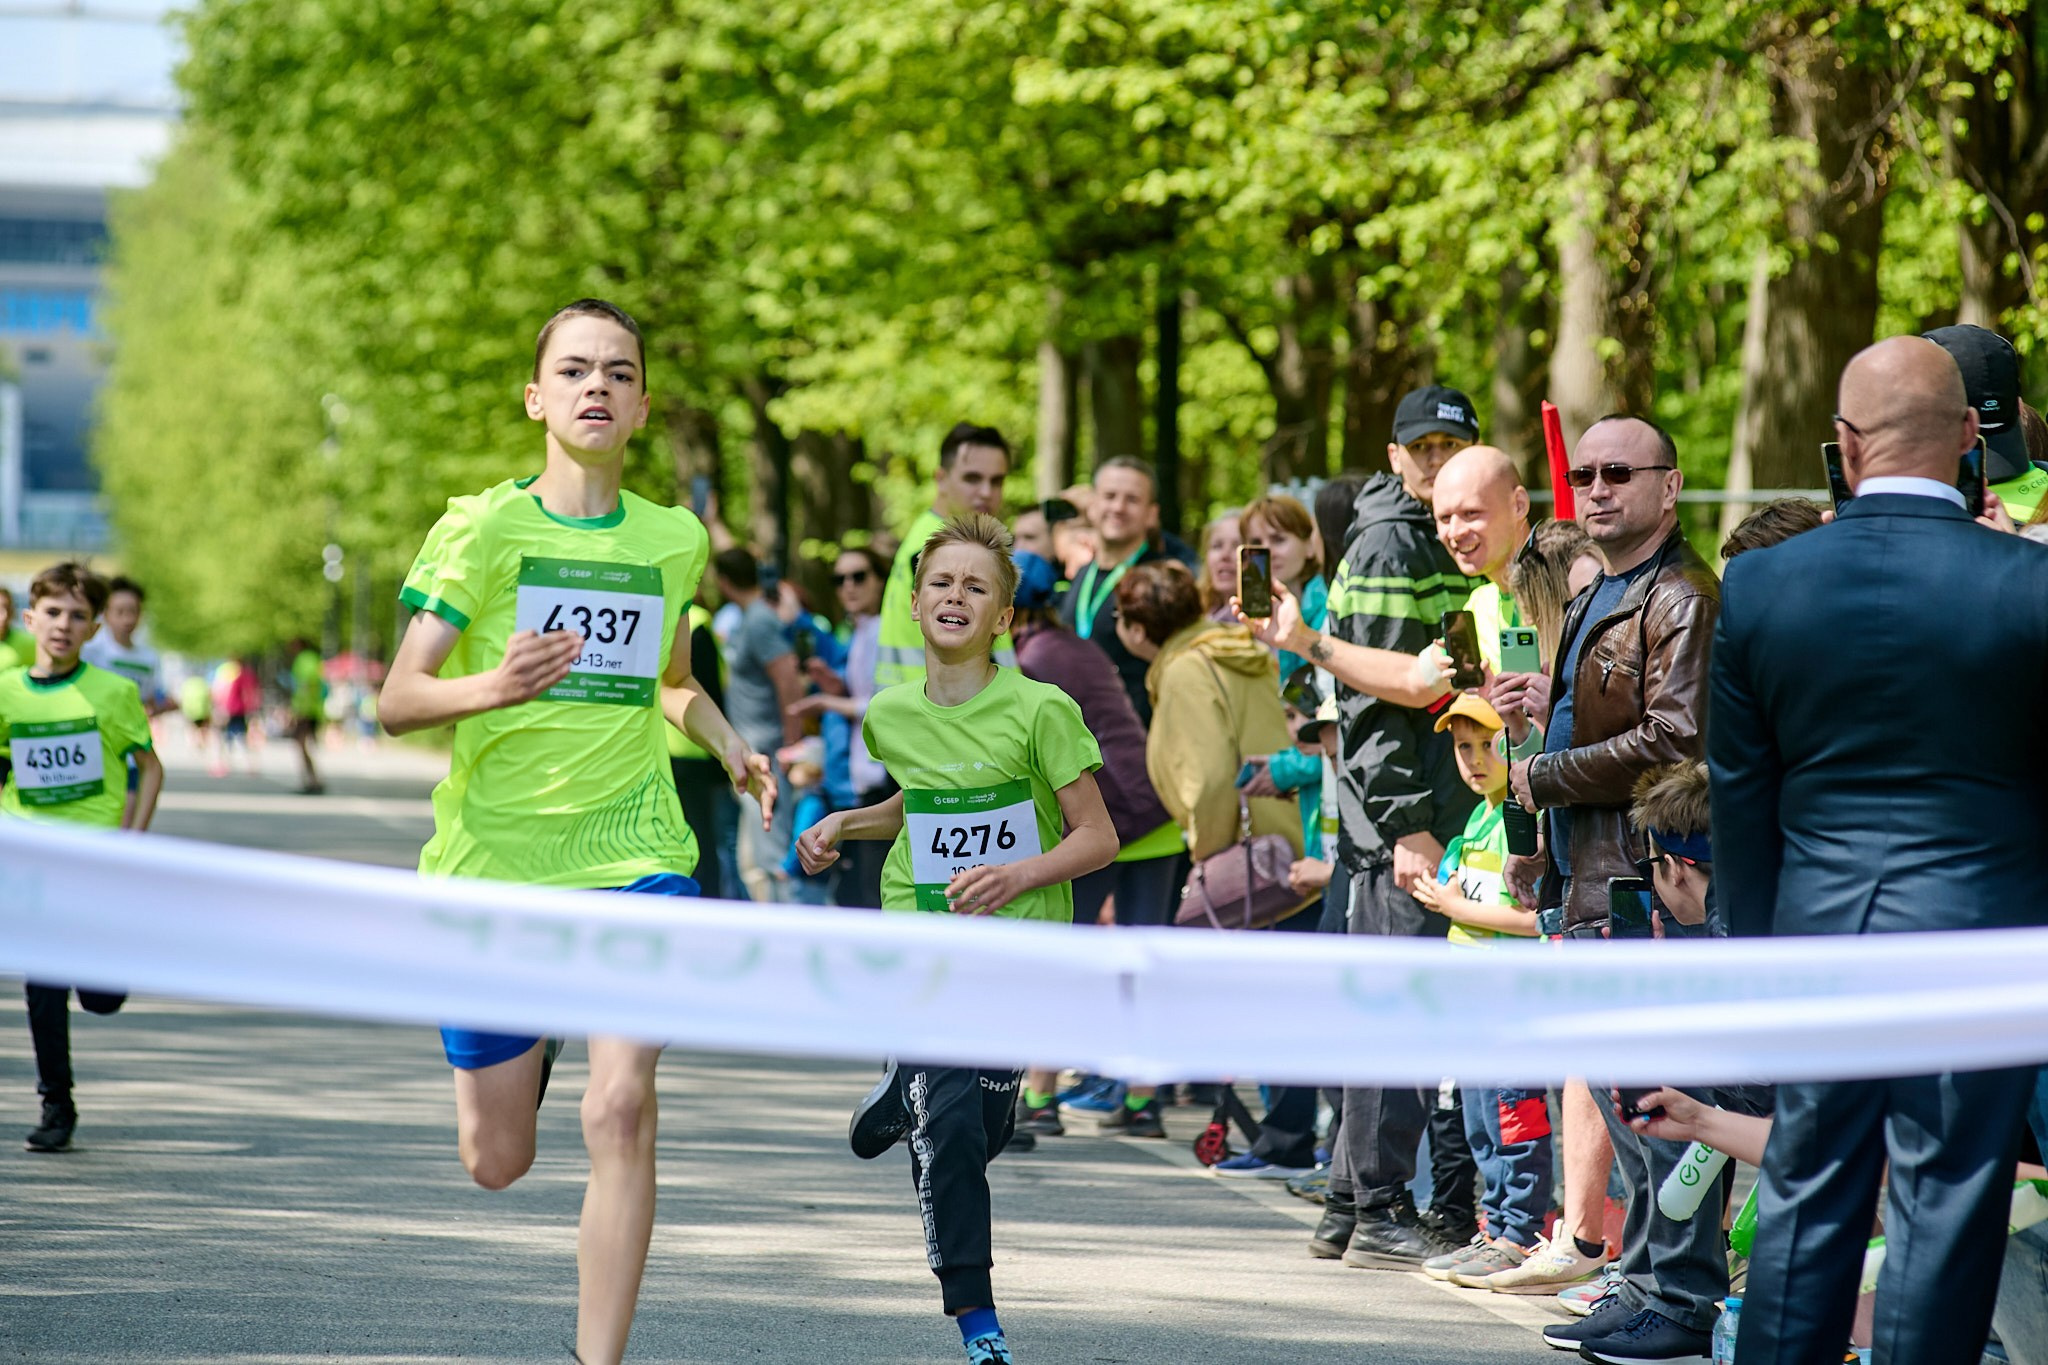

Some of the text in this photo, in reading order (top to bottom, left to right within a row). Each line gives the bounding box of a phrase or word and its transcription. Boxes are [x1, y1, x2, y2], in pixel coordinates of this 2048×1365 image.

[542, 604, 641, 646] 4337
[571, 652, 623, 669] 0-13 лет
[26, 741, 87, 770] 4306
[931, 819, 1016, 858] 4276
